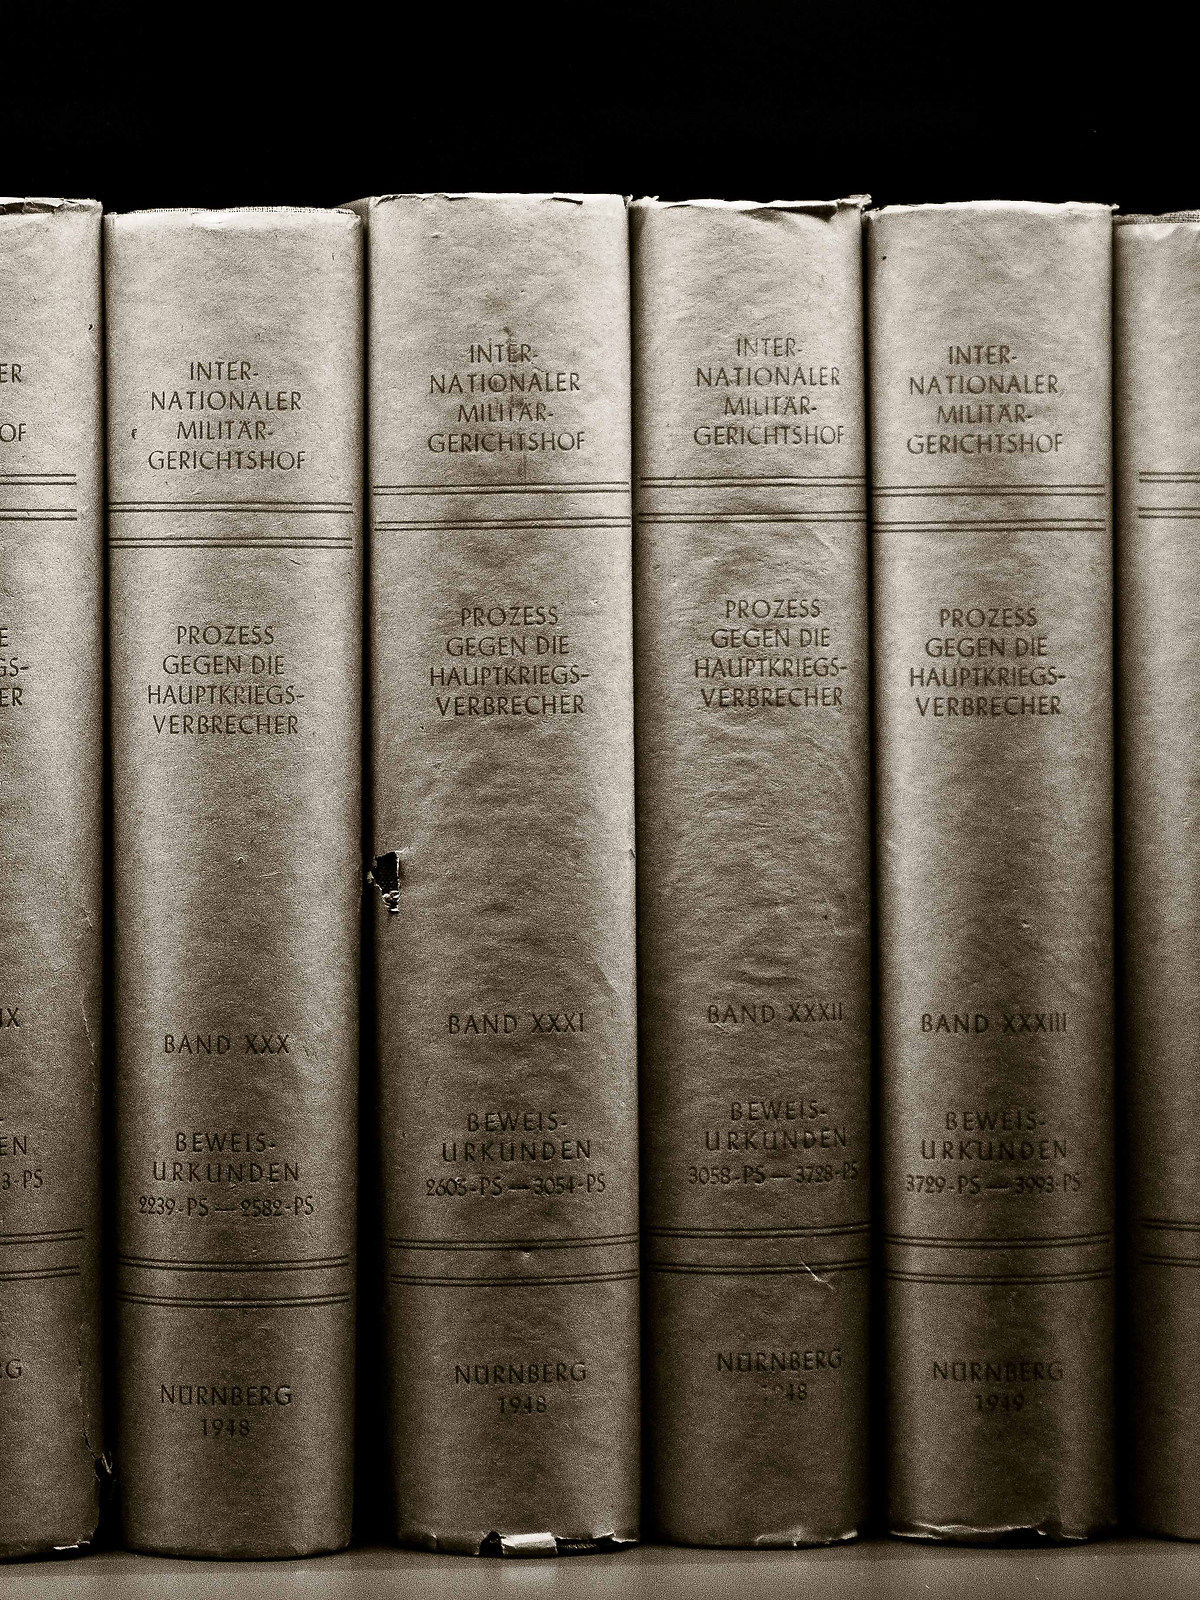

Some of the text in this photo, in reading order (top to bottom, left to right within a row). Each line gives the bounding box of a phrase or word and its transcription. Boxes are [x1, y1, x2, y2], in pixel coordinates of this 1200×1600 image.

[469, 343, 539, 364] INTER-
[735, 335, 803, 357] INTER-
[948, 344, 1017, 365] INTER-
[189, 361, 259, 382] INTER-
[696, 367, 840, 387] NATIONALER
[429, 372, 581, 394] NATIONALER
[909, 375, 1058, 396] NATIONALER
[150, 391, 302, 411] NATIONALER
[723, 395, 817, 416] MILITÄR-
[457, 401, 553, 423] MILITÄR-
[937, 403, 1033, 425] MILITÄR-
[176, 420, 273, 440] MILITÄR-
[693, 425, 845, 447] GERICHTSHOF
[427, 432, 586, 454] GERICHTSHOF
[906, 433, 1063, 455] GERICHTSHOF
[148, 450, 306, 471] GERICHTSHOF
[460, 606, 559, 627] PROZESS
[725, 598, 821, 619] PROZESS
[940, 607, 1038, 628] PROZESS
[176, 625, 275, 646] PROZESS
[710, 628, 831, 649] GEGEN DIE
[446, 636, 570, 657] GEGEN DIE
[925, 637, 1048, 658] GEGEN DIE
[162, 655, 285, 676] GEGEN DIE
[429, 665, 589, 687] HAUPTKRIEGS-
[694, 657, 847, 678] HAUPTKRIEGS-
[910, 666, 1066, 688] HAUPTKRIEGS-
[147, 684, 305, 707] HAUPTKRIEGS-
[435, 695, 585, 717] VERBRECHER
[700, 686, 843, 709] VERBRECHER
[915, 696, 1062, 717] VERBRECHER
[153, 714, 299, 735] VERBRECHER
[707, 1002, 843, 1024] BAND XXXII
[921, 1013, 1067, 1033] BAND XXXIII
[449, 1013, 585, 1035] BAND XXXI
[164, 1034, 290, 1054] BAND XXX
[467, 1111, 568, 1132] BEWEIS-
[731, 1101, 828, 1121] BEWEIS-
[945, 1110, 1045, 1131] BEWEIS-
[176, 1132, 276, 1153] BEWEIS-
[706, 1127, 847, 1151] URKUNDEN
[442, 1139, 591, 1162] URKUNDEN
[922, 1140, 1067, 1161] URKUNDEN
[153, 1162, 299, 1183] URKUNDEN
[499, 1394, 547, 1415] 1948
[202, 1417, 251, 1438] 1948
